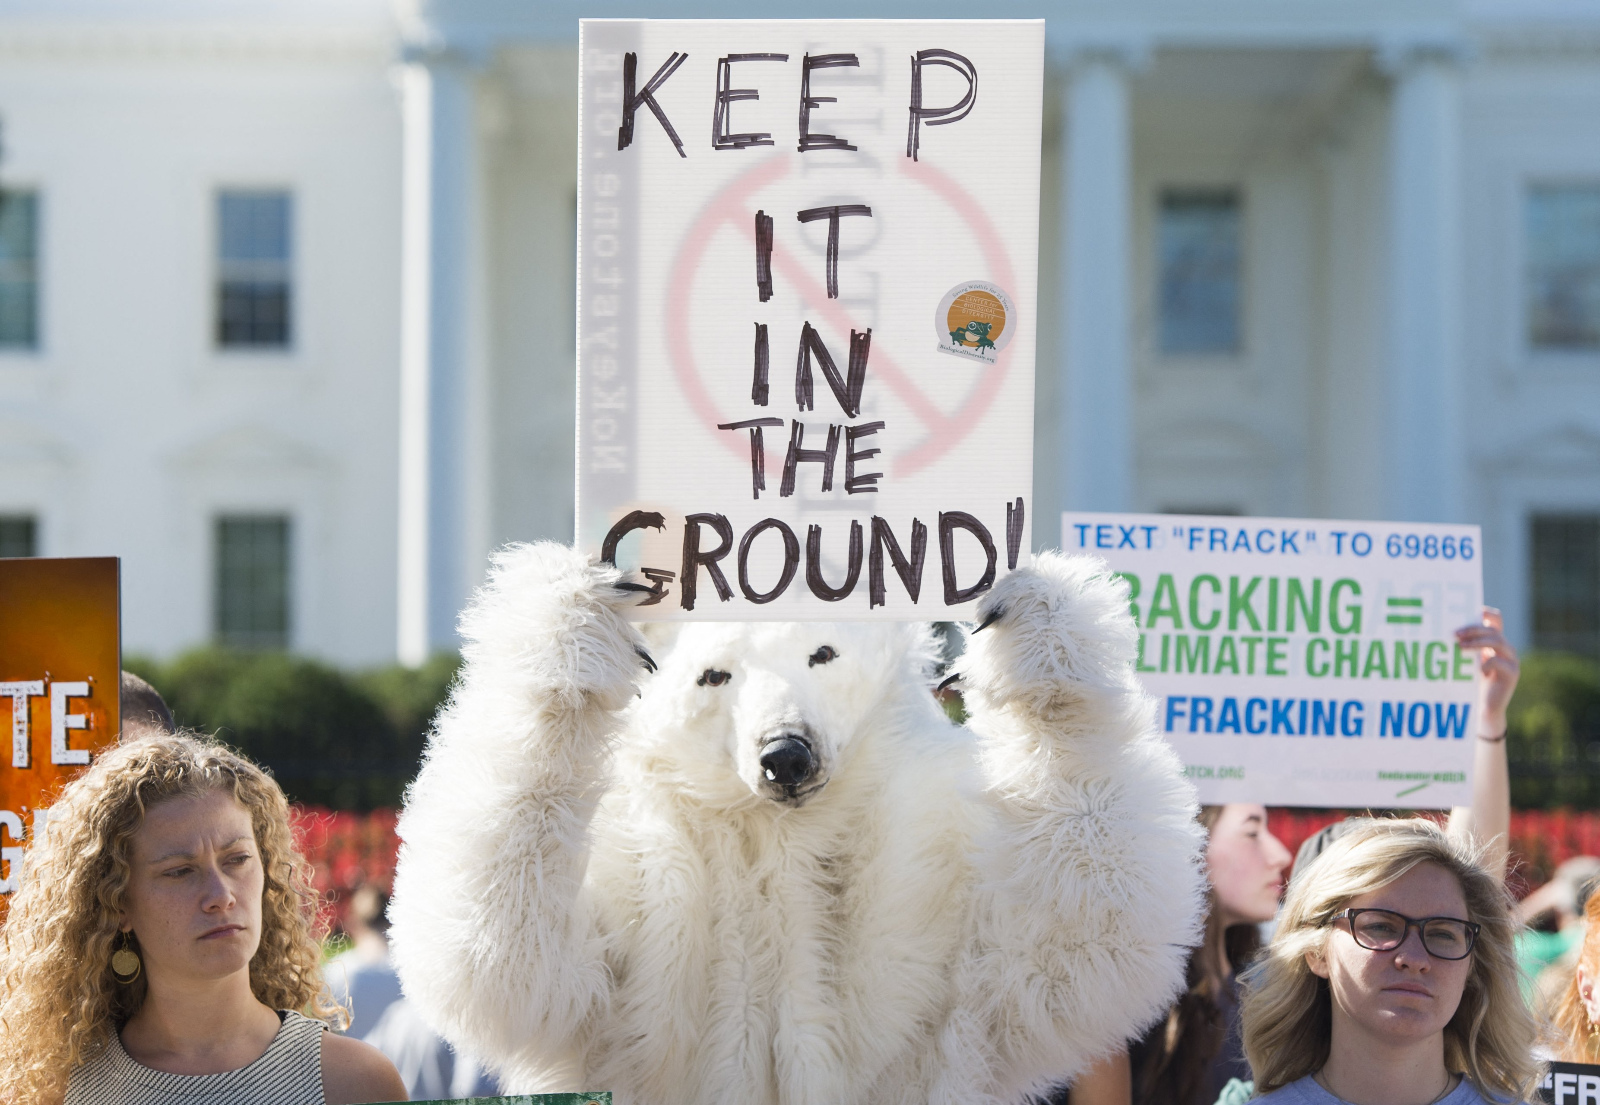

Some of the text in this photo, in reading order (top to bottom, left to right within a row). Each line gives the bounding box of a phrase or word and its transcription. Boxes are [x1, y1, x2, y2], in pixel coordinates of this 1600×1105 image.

[617, 49, 978, 162] KEEP
[755, 205, 872, 302] IT
[961, 308, 994, 320] DIVERSITY
[963, 303, 996, 315] BIOLOGICAL
[965, 296, 988, 306] CENTER
[752, 321, 872, 418] IN
[717, 417, 885, 500] THE
[601, 496, 1024, 611] GROUND!
[1073, 523, 1475, 561] TEXT "FRACK" TO 69866
[1110, 571, 1362, 634] RACKING
[1135, 634, 1473, 681] LIMATE CHANGE
[0, 680, 90, 768] TE
[1165, 696, 1470, 739] FRACKING NOW
